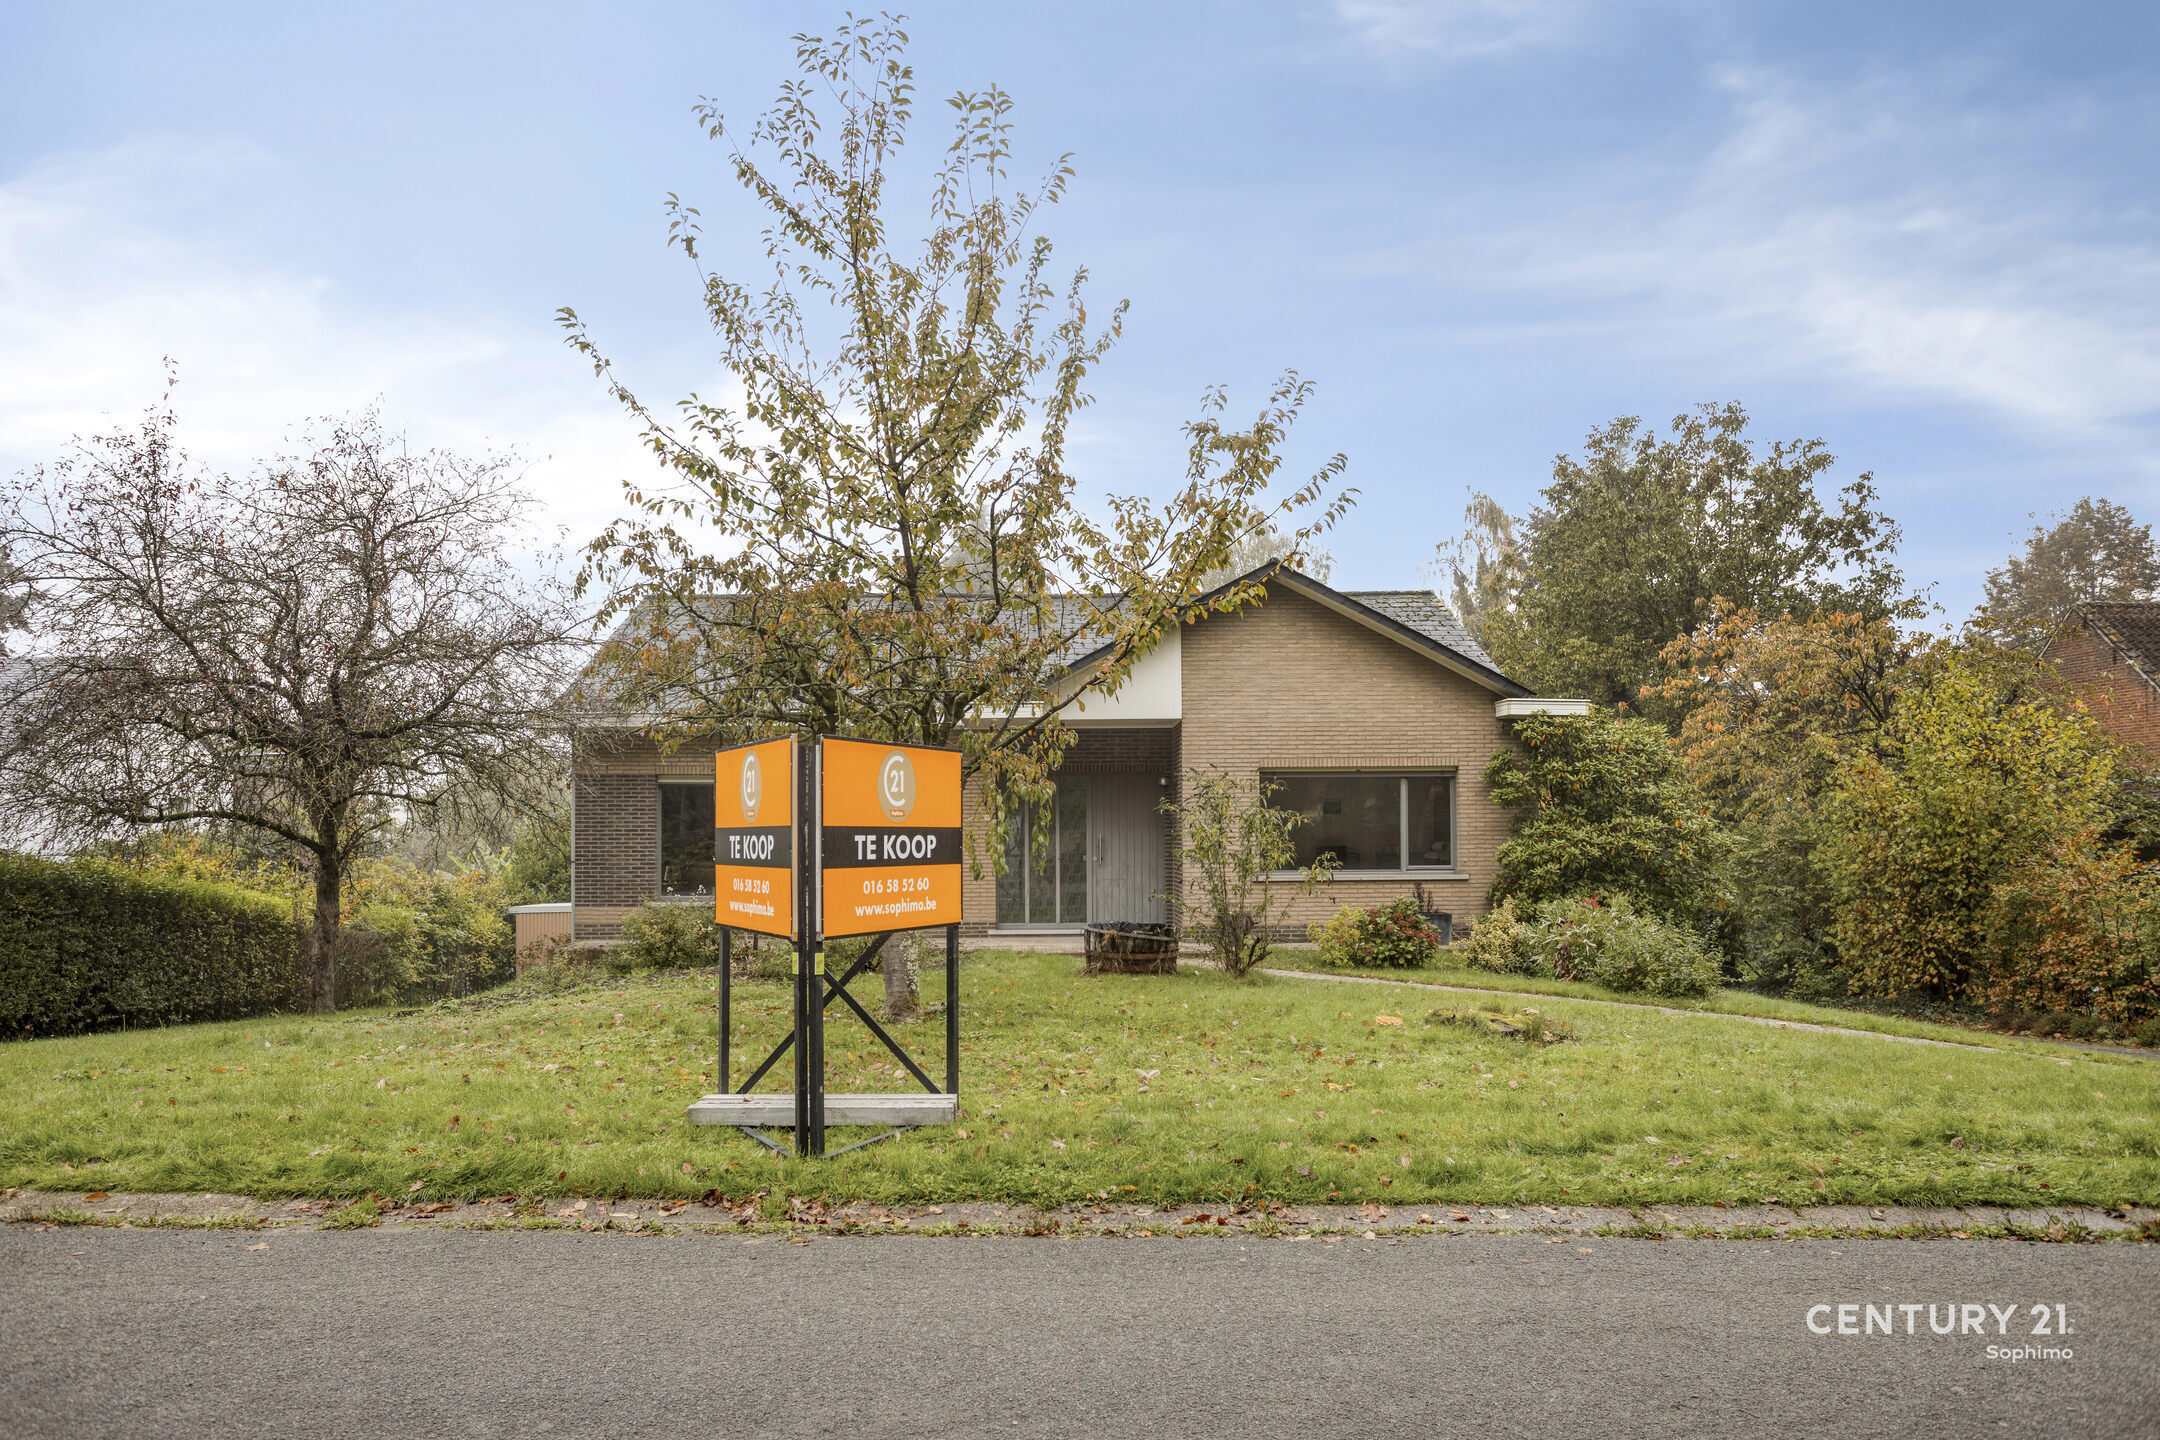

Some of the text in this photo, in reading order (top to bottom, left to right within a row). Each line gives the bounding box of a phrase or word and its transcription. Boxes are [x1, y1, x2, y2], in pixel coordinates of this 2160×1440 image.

[729, 834, 775, 860] TE KOOP
[854, 834, 937, 860] TE KOOP
[733, 877, 770, 895] 016 58 52 60
[863, 877, 930, 895] 016 58 52 60
[729, 899, 775, 918] www.sophimo.be
[854, 895, 937, 918] www.sophimo.be
